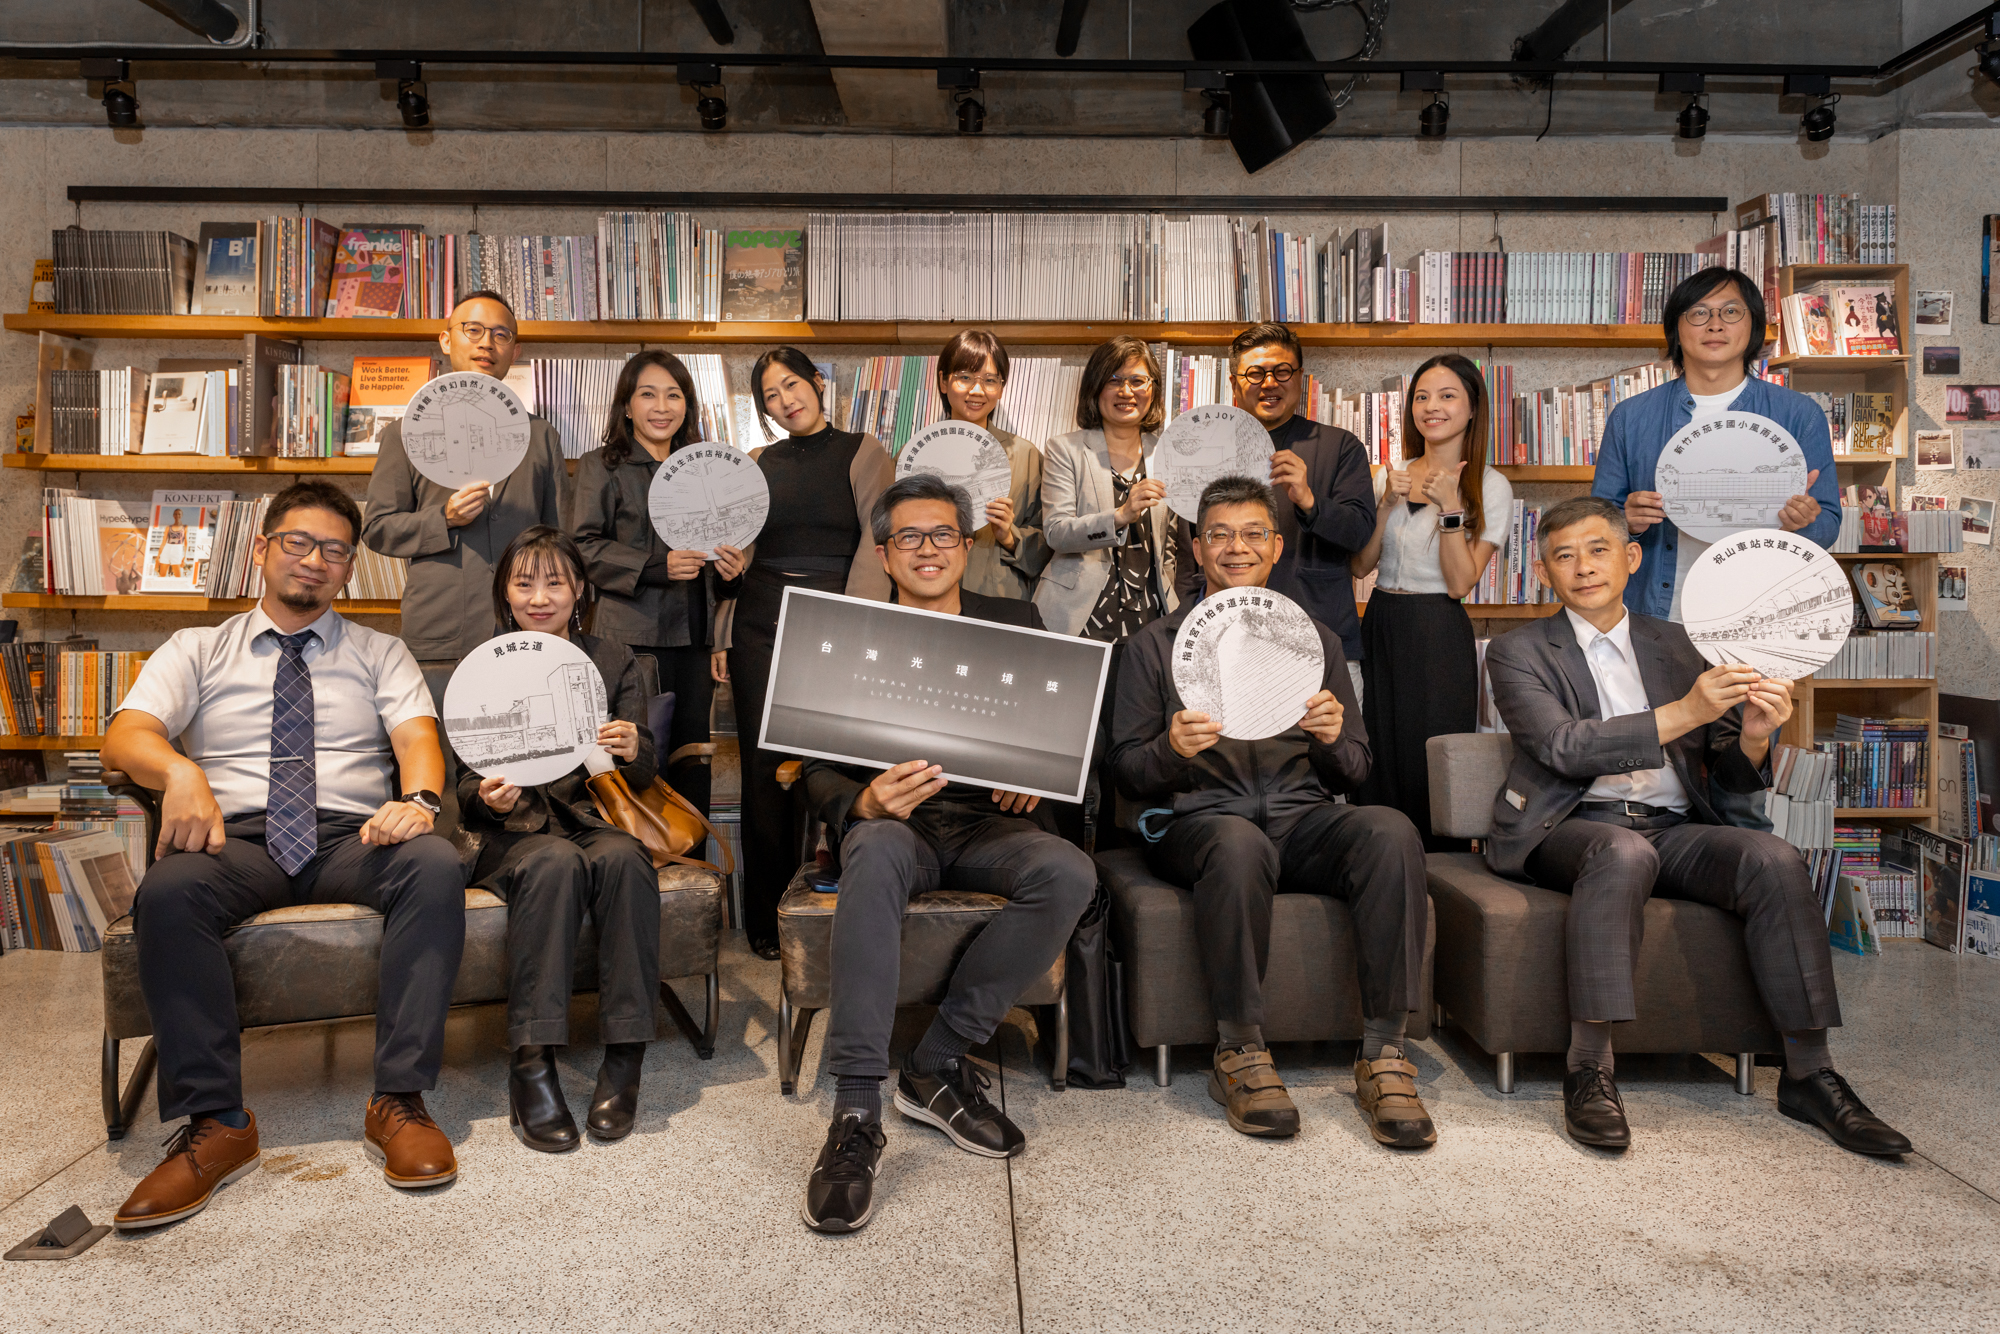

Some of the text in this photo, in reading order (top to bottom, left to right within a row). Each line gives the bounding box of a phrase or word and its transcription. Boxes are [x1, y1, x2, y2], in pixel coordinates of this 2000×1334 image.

[347, 237, 402, 252] frankie
[727, 230, 802, 248] POPEYE
[228, 240, 243, 256] B
[265, 346, 296, 361] KINFOLK
[246, 390, 251, 400] OF
[1856, 395, 1874, 409] BLUE
[1215, 412, 1235, 421] JOY
[1855, 409, 1878, 422] GIANT
[1674, 420, 1789, 455] 新竹市茄苳國小風雨球場
[1854, 423, 1870, 436] SUP
[904, 427, 990, 471] 國家漫畫博物館園區光環境
[663, 450, 742, 482] 誠品生活新店裕隆城
[164, 494, 222, 503] KONFEKT
[1713, 539, 1815, 565] 祝山車站改建工程
[1182, 596, 1273, 661] 指南宮竹柏參道光環境
[494, 641, 543, 658] 見城之道
[821, 640, 1059, 693] 台灣光環境獎
[854, 674, 1018, 707] TAIWAN ENVIRONMENT
[870, 690, 996, 717] LIGHTING AWARD
[1911, 832, 1941, 853] GROOVE
